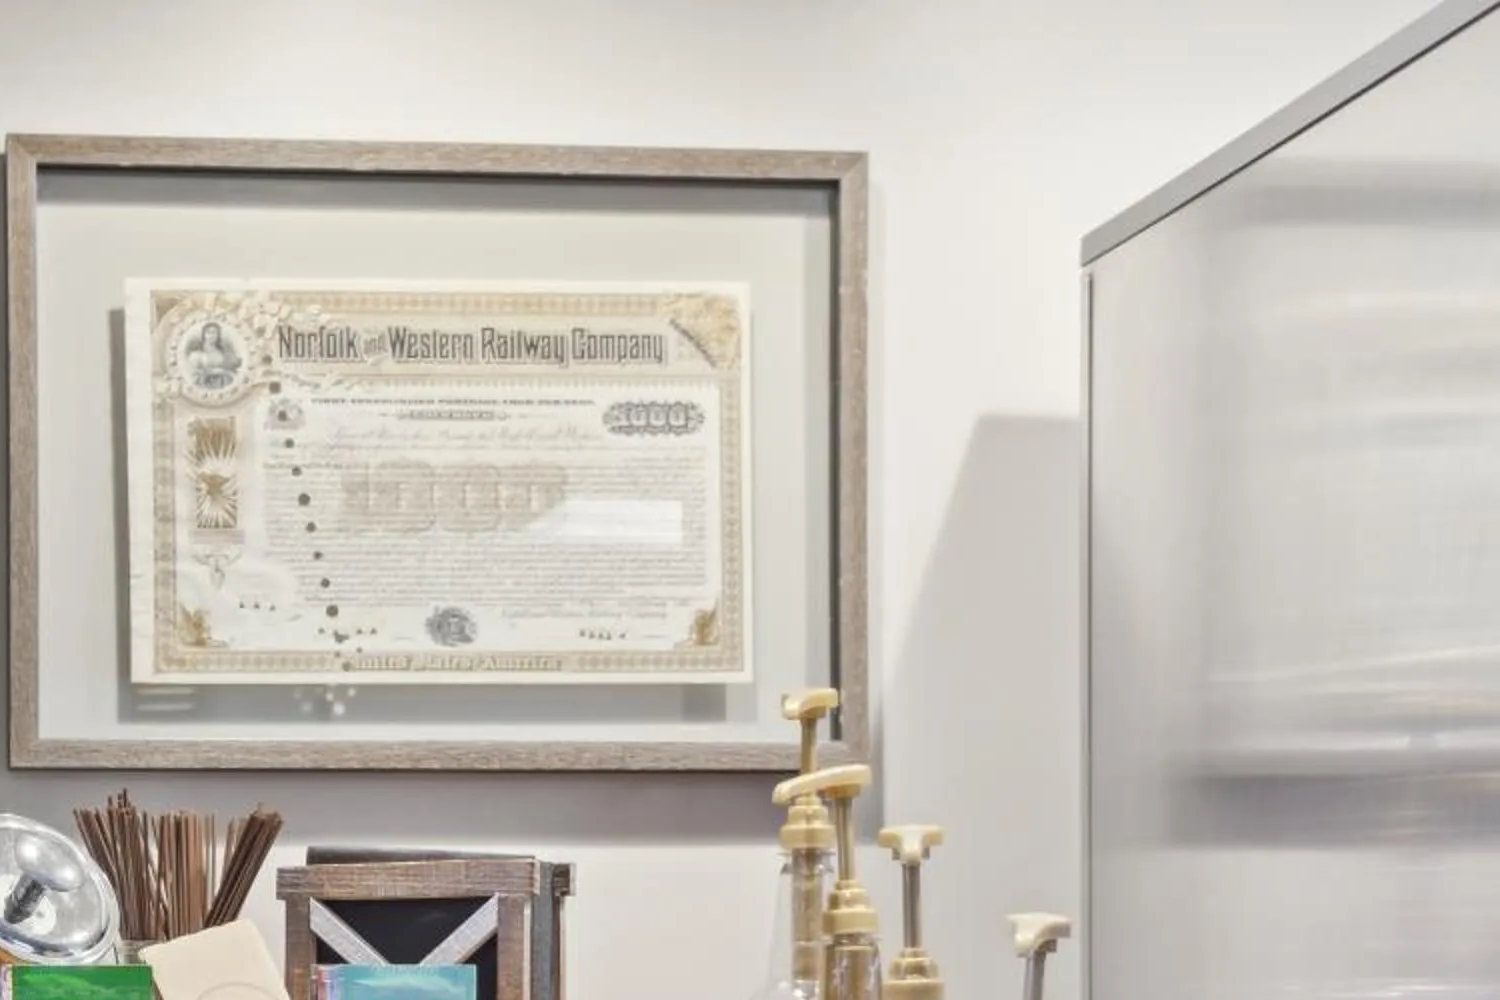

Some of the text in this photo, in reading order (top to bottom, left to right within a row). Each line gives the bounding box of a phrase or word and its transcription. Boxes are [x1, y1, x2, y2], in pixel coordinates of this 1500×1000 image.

[277, 325, 362, 362] Norfolk
[386, 326, 475, 363] Western
[480, 326, 568, 367] Railway
[570, 327, 665, 366] Company
